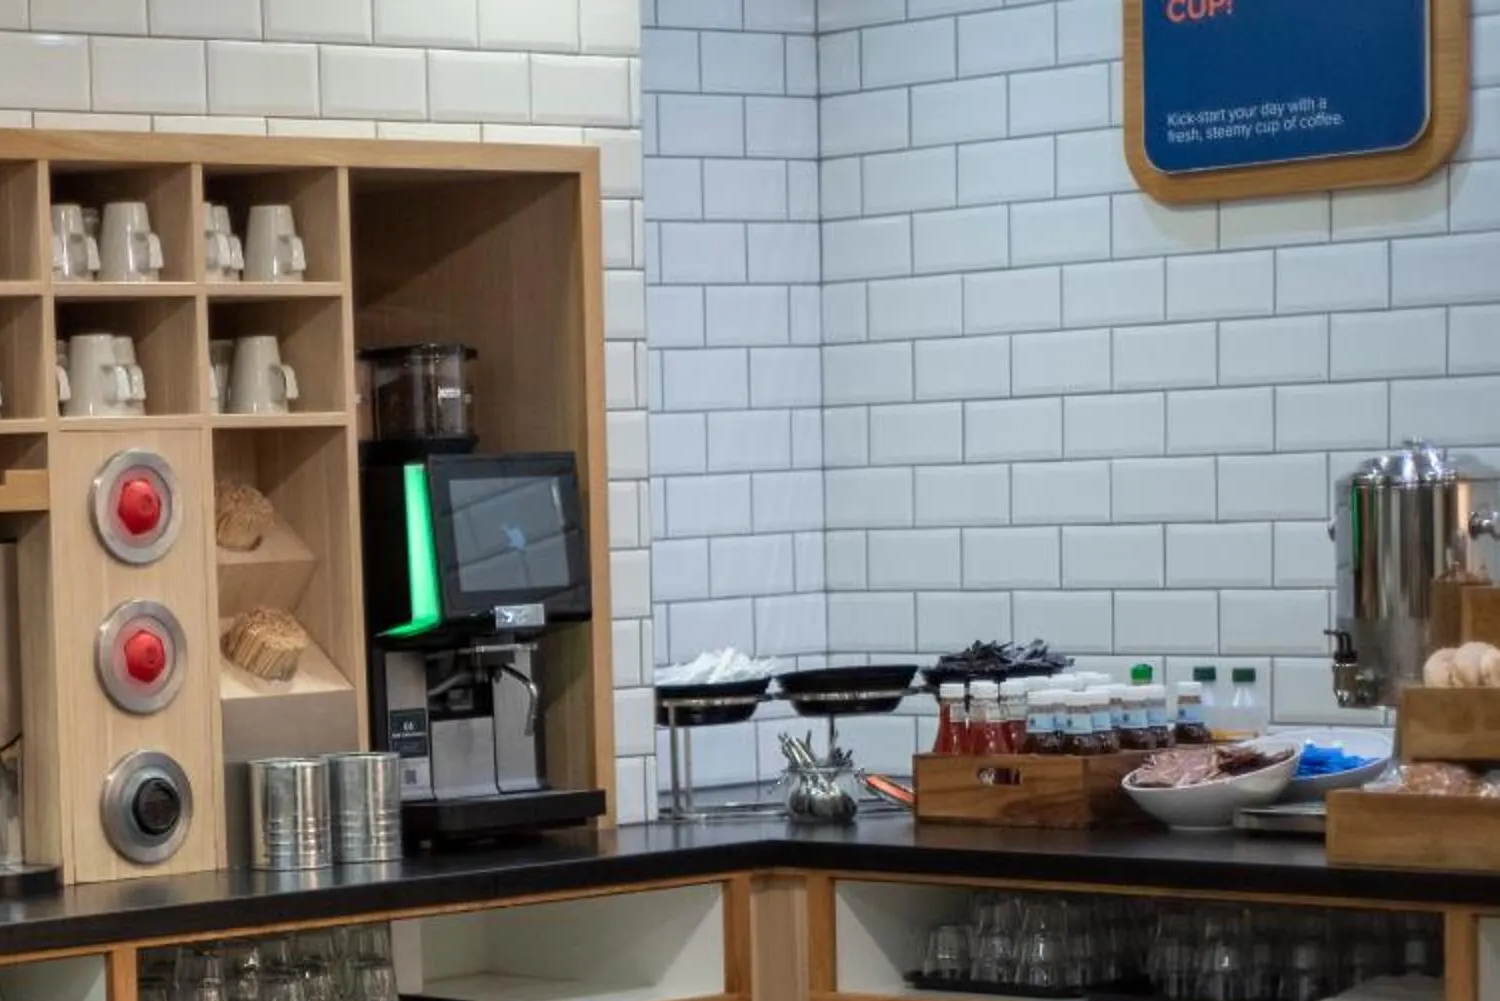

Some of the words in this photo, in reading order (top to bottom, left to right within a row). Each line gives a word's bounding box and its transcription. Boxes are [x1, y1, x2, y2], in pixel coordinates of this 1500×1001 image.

[1165, 0, 1233, 22] CUP!
[1167, 110, 1226, 127] Kick-start
[1228, 106, 1258, 124] your
[1261, 100, 1285, 118] day
[1287, 97, 1316, 113] with
[1317, 97, 1328, 110] a
[1167, 127, 1204, 144] fresh,
[1205, 122, 1252, 141] steamy
[1255, 120, 1281, 137] cup
[1283, 115, 1298, 131] of
